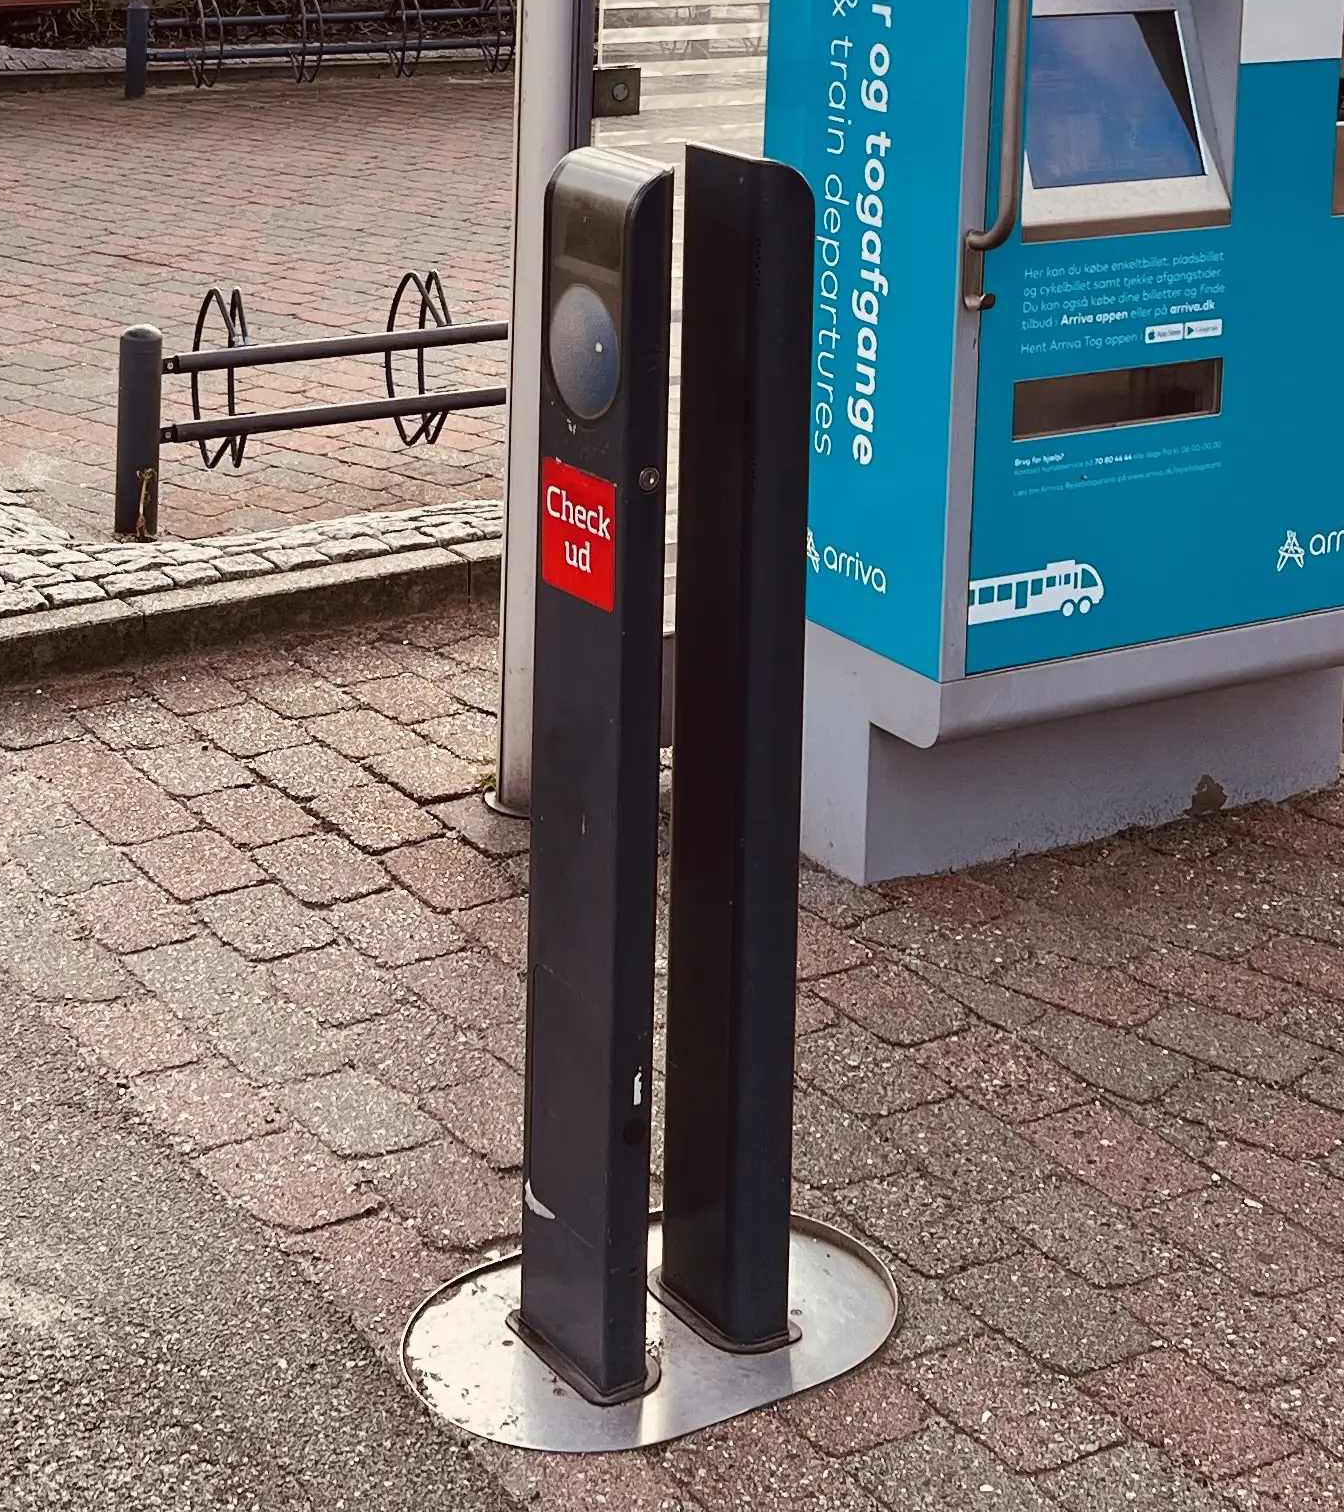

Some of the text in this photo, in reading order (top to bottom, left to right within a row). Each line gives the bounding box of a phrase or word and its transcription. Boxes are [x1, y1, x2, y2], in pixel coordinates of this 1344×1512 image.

[827, 35, 853, 155] train
[861, 43, 890, 113] og
[1024, 287, 1036, 298] og
[1094, 278, 1120, 289] samt
[1124, 273, 1153, 288] tjekke
[1025, 268, 1044, 279] Her
[1046, 266, 1065, 277] kan
[1068, 264, 1081, 274] du
[1084, 262, 1109, 273] købe
[815, 174, 850, 456] departures
[848, 131, 891, 465] togafgange
[1022, 316, 1052, 330] tilbud
[1060, 312, 1093, 326] Arriva
[1096, 310, 1128, 324] appen
[1130, 307, 1152, 318] eller
[1154, 304, 1167, 318] på
[1170, 299, 1215, 314] arriva.dk
[1023, 283, 1225, 313] Du kan også købe dine billetter og finde
[1021, 342, 1046, 354] Hent
[1049, 339, 1081, 350] Arriva
[1084, 336, 1102, 348] Tog
[1105, 334, 1137, 347] appen
[547, 486, 611, 540] Check
[565, 541, 591, 573] ud
[823, 546, 886, 594] arriva
